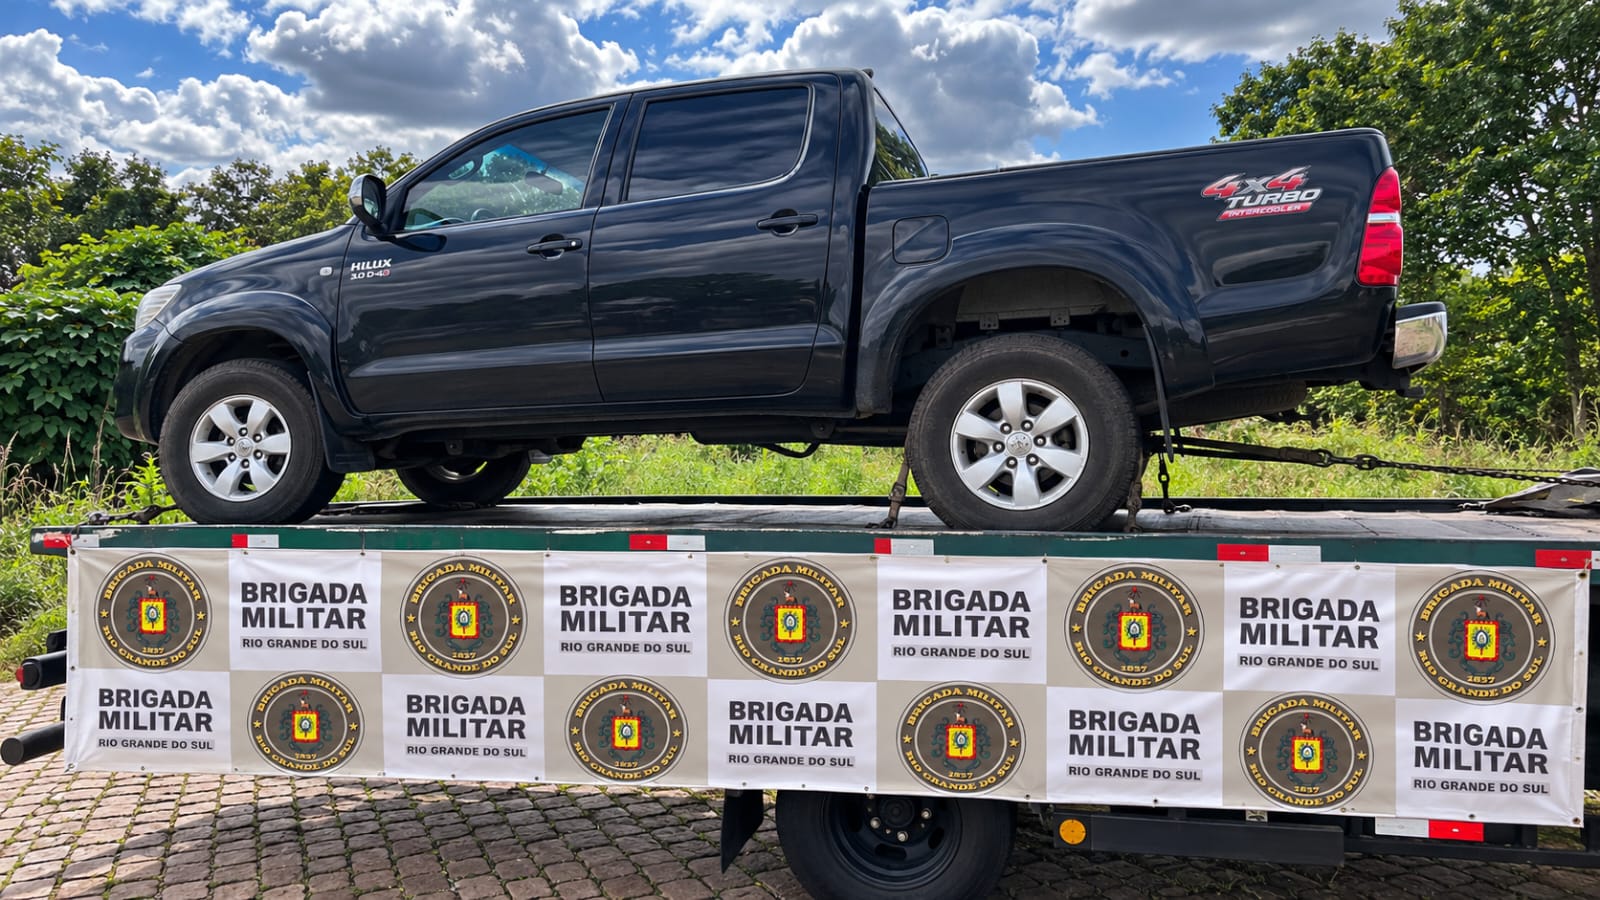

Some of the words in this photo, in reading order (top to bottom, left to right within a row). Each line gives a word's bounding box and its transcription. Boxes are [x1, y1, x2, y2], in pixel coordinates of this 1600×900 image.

[1226, 188, 1323, 209] TURBO
[1228, 204, 1301, 217] INTERCOOLER
[350, 258, 392, 271] HILUX
[103, 559, 153, 600] BRIGADA
[157, 560, 201, 600] MILITAR
[409, 562, 465, 604] BRIGADA
[468, 563, 516, 606] MILITAR
[735, 564, 793, 607] BRIGADA
[794, 564, 845, 609] MILITAR
[241, 582, 368, 604] BRIGADA
[560, 585, 692, 608] BRIGADA
[893, 589, 1031, 613] BRIGADA
[1075, 570, 1137, 614] BRIGADA
[1140, 570, 1192, 616] MILITAR
[1420, 577, 1485, 622] BRIGADA
[1488, 578, 1543, 625] MILITAR
[241, 606, 366, 630] MILITAR
[560, 610, 691, 633] MILITAR
[1239, 596, 1380, 623] BRIGADA
[893, 614, 1030, 639] MILITAR
[1239, 622, 1379, 649] MILITAR
[118, 647, 168, 667] GRANDE
[169, 650, 187, 664] DO
[186, 630, 203, 651] SUL
[242, 638, 263, 648] RIO
[266, 638, 318, 649] GRANDE
[321, 639, 339, 649] DO
[342, 639, 367, 650] SUL
[426, 653, 481, 672] GRANDE
[481, 655, 500, 669] DO
[499, 633, 517, 657] SUL
[560, 642, 583, 652] RIO
[586, 642, 640, 653] GRANDE
[643, 643, 662, 653] DO
[665, 643, 691, 654] SUL
[893, 646, 916, 657] RIO
[920, 647, 976, 658] GRANDE
[980, 648, 1000, 659] DO
[1003, 648, 1030, 659] SUL
[751, 657, 806, 677] GRANDE
[808, 659, 827, 673] DO
[827, 639, 846, 661] SUL
[1092, 665, 1150, 686] GRANDE
[1153, 668, 1173, 683] DO
[1172, 647, 1193, 670] SUL
[1239, 655, 1263, 666] RIO
[1267, 656, 1324, 668] GRANDE
[1328, 658, 1348, 669] DO
[1352, 659, 1379, 671] SUL
[1437, 675, 1498, 698] GRANDE
[1501, 680, 1522, 695] DO
[1522, 657, 1543, 681] SUL
[98, 688, 213, 710] BRIGADA
[255, 676, 307, 712] BRIGADA
[310, 676, 353, 714] MILITAR
[406, 694, 526, 716] BRIGADA
[575, 681, 628, 718] BRIGADA
[631, 682, 677, 720] MILITAR
[729, 700, 853, 724] BRIGADA
[906, 687, 963, 726] BRIGADA
[966, 687, 1014, 729] MILITAR
[1250, 697, 1310, 738] BRIGADA
[1312, 698, 1362, 741] MILITAR
[98, 710, 213, 733] MILITAR
[406, 717, 526, 740] MILITAR
[1069, 709, 1201, 735] BRIGADA
[98, 738, 118, 748] RIO
[120, 739, 168, 749] GRANDE
[171, 740, 188, 750] DO
[190, 740, 213, 750] SUL
[729, 724, 854, 748] MILITAR
[1069, 733, 1201, 761] MILITAR
[1413, 720, 1548, 751] BRIGADA
[271, 753, 320, 771] GRANDE
[322, 756, 339, 769] DO
[338, 738, 355, 758] SUL
[406, 745, 427, 755] RIO
[430, 746, 479, 756] GRANDE
[483, 747, 500, 757] DO
[503, 747, 526, 758] SUL
[590, 762, 642, 780] GRANDE
[643, 764, 661, 777] DO
[660, 746, 678, 766] SUL
[728, 754, 750, 764] RIO
[753, 755, 805, 766] GRANDE
[808, 756, 826, 766] DO
[829, 757, 854, 767] SUL
[1414, 745, 1549, 775] MILITAR
[922, 771, 977, 791] GRANDE
[979, 775, 997, 788] DO
[998, 755, 1016, 777] SUL
[1068, 765, 1091, 777] RIO
[1094, 767, 1149, 779] GRANDE
[1152, 769, 1171, 780] DO
[1175, 770, 1201, 781] SUL
[1267, 786, 1323, 806] GRANDE
[1326, 790, 1345, 804] DO
[1343, 769, 1364, 792] SUL
[1413, 779, 1437, 790] RIO
[1440, 780, 1496, 793] GRANDE
[1499, 782, 1519, 793] DO
[1522, 783, 1549, 795] SUL
